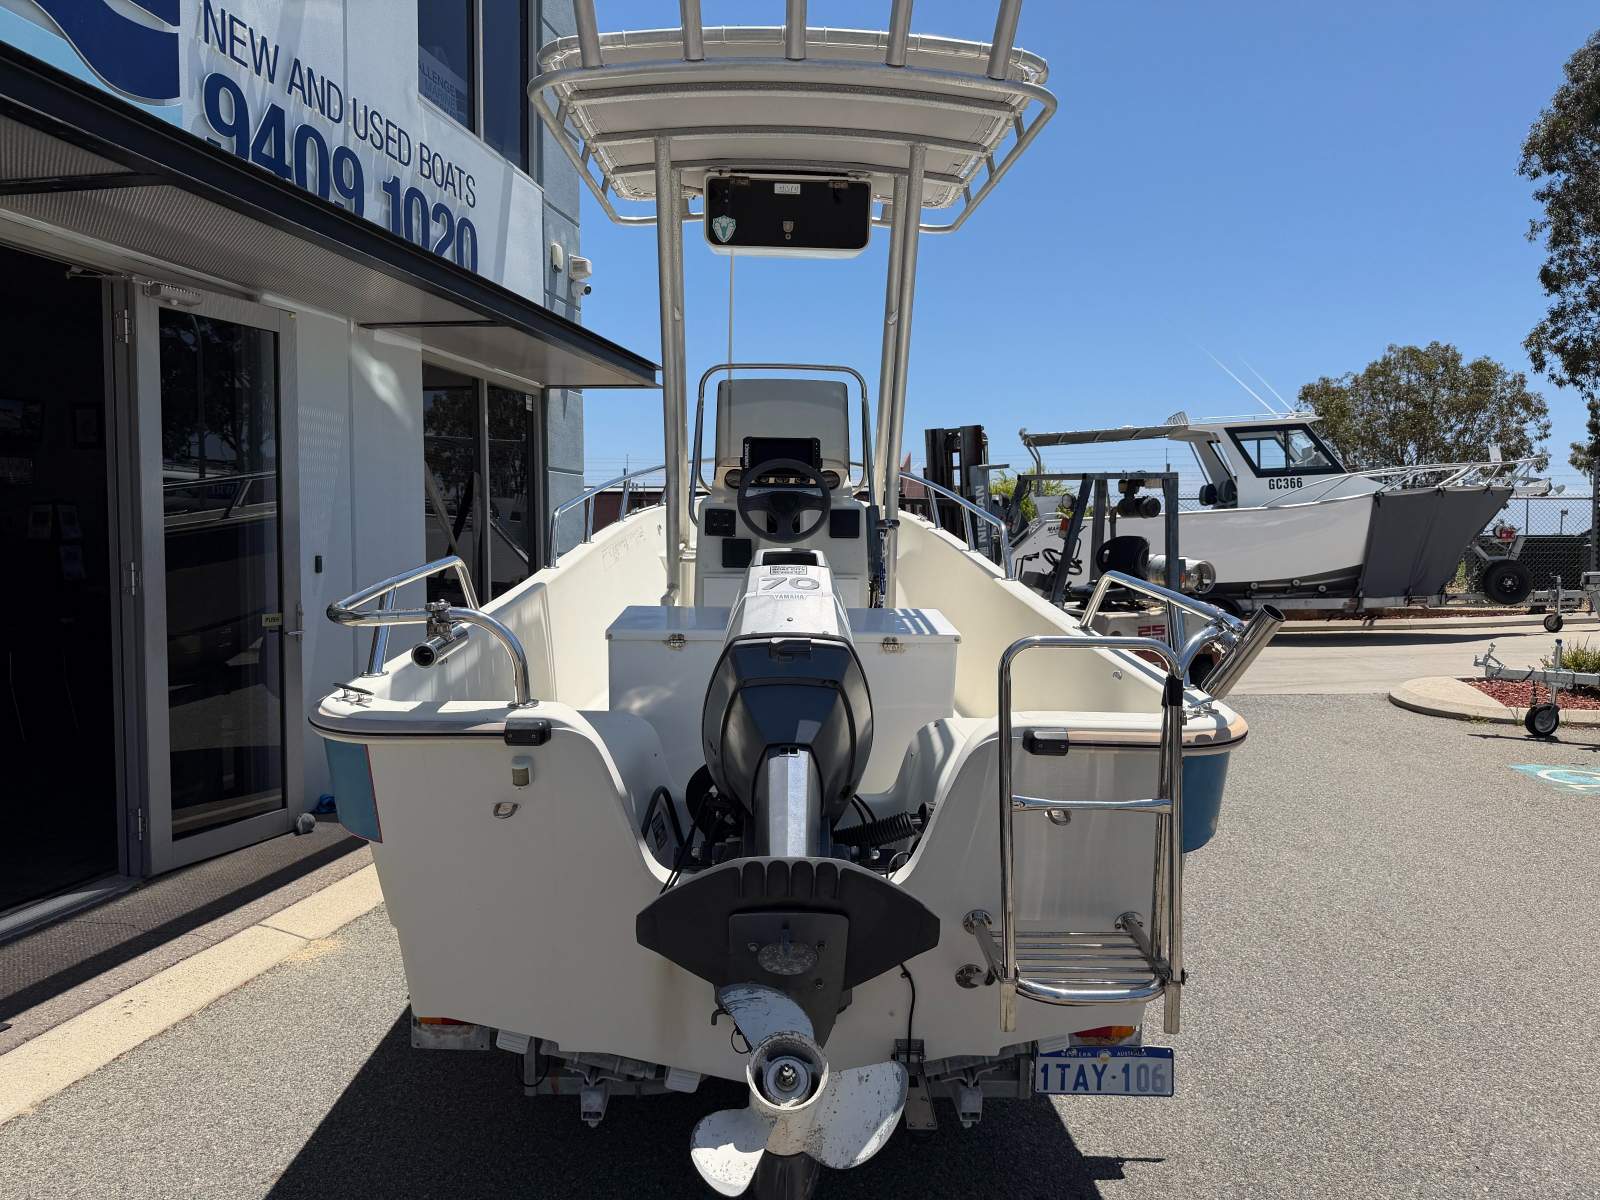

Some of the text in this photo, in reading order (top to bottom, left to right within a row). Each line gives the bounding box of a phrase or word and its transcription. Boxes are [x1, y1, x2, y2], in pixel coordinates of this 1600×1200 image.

[204, 0, 476, 208] NEW AND USED BOATS
[203, 72, 478, 274] 9409 1020
[1269, 477, 1303, 490] GC366
[976, 485, 988, 543] NISAN
[761, 577, 820, 590] 70
[1137, 624, 1165, 637] 25
